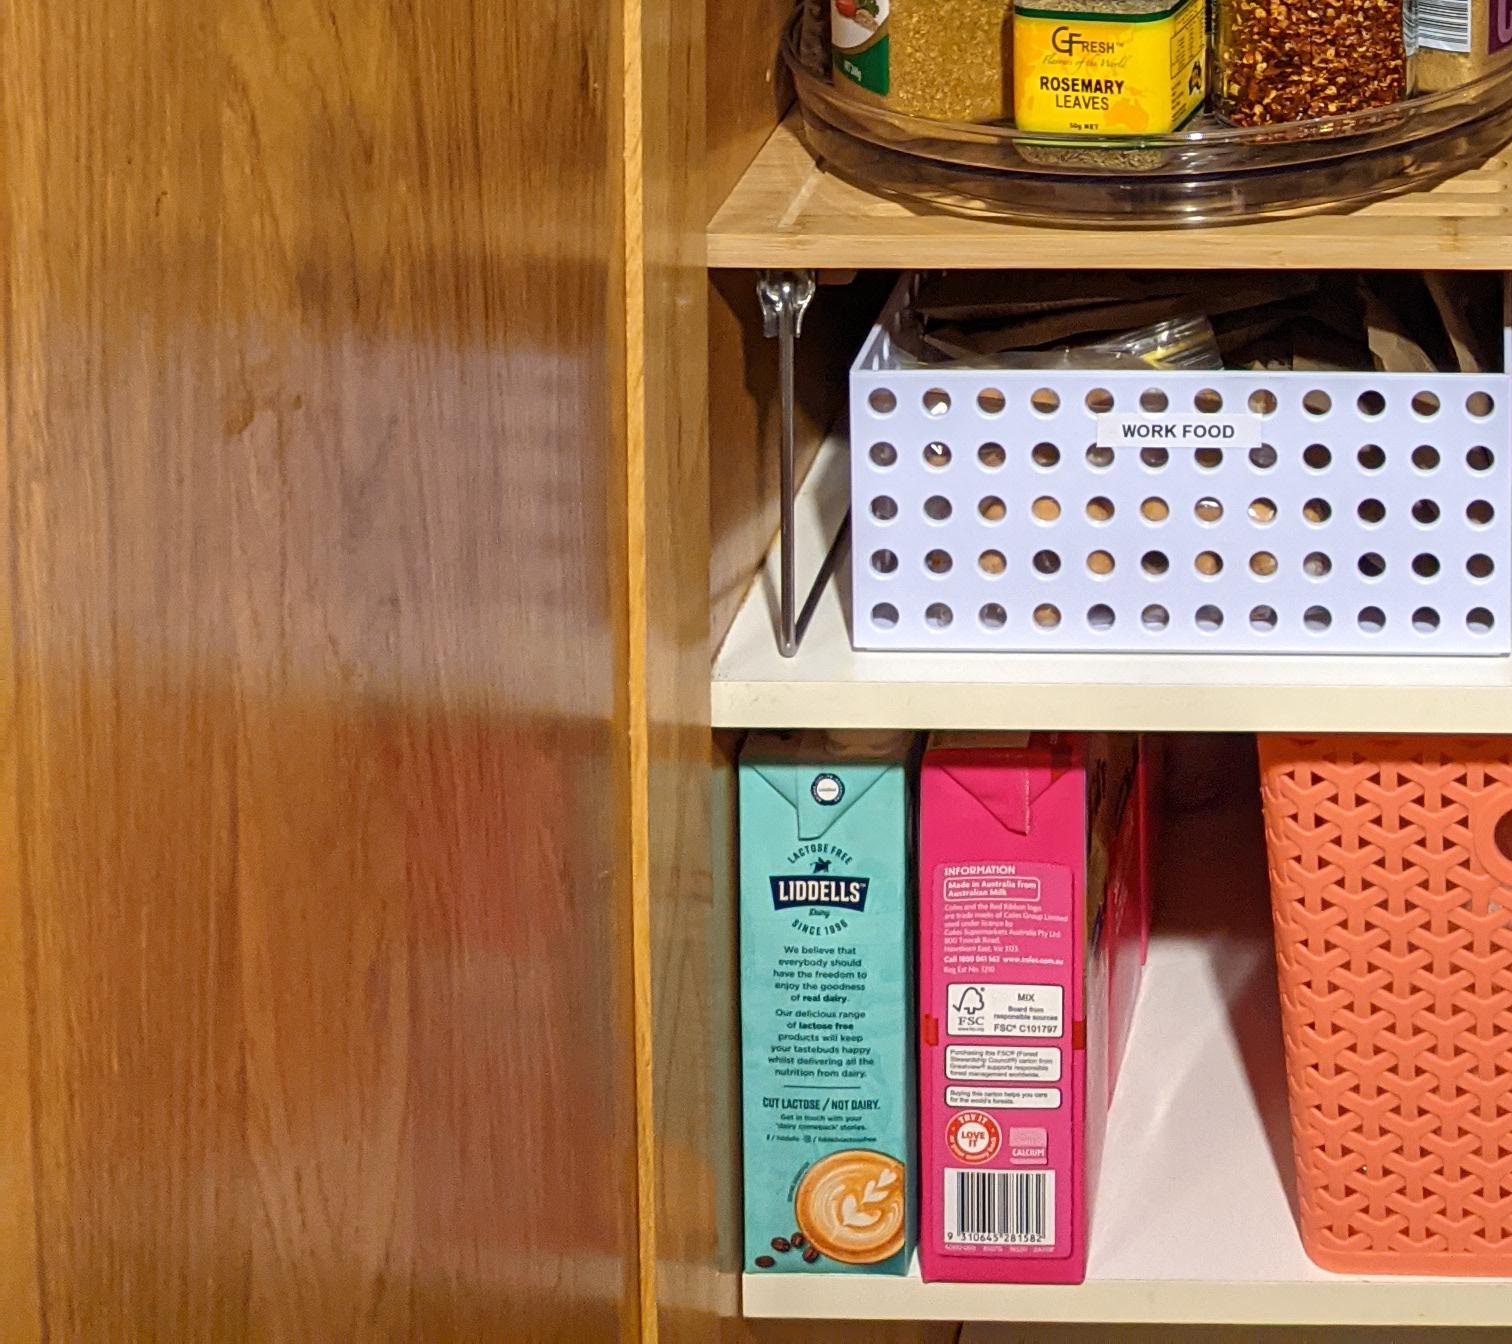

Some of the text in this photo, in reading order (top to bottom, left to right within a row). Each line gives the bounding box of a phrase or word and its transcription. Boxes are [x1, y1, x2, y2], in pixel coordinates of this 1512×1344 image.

[1040, 76, 1124, 94] ROSEMARY
[1056, 95, 1109, 110] LEAVES
[1121, 424, 1235, 439] WORK FOOD
[787, 844, 853, 865] LACTOSE FREE
[944, 866, 1015, 876] INFORMATION
[779, 880, 860, 902] LIDDELLS
[792, 919, 821, 936] SINCE
[784, 946, 856, 955] We believe that
[779, 958, 861, 968] everybody should
[1017, 993, 1035, 1001] MIX
[959, 1016, 984, 1025] FSC
[1019, 1024, 1057, 1032] C101797
[763, 1097, 779, 1109] CUT
[782, 1098, 820, 1110] LACTOSE
[832, 1099, 849, 1110] NOT
